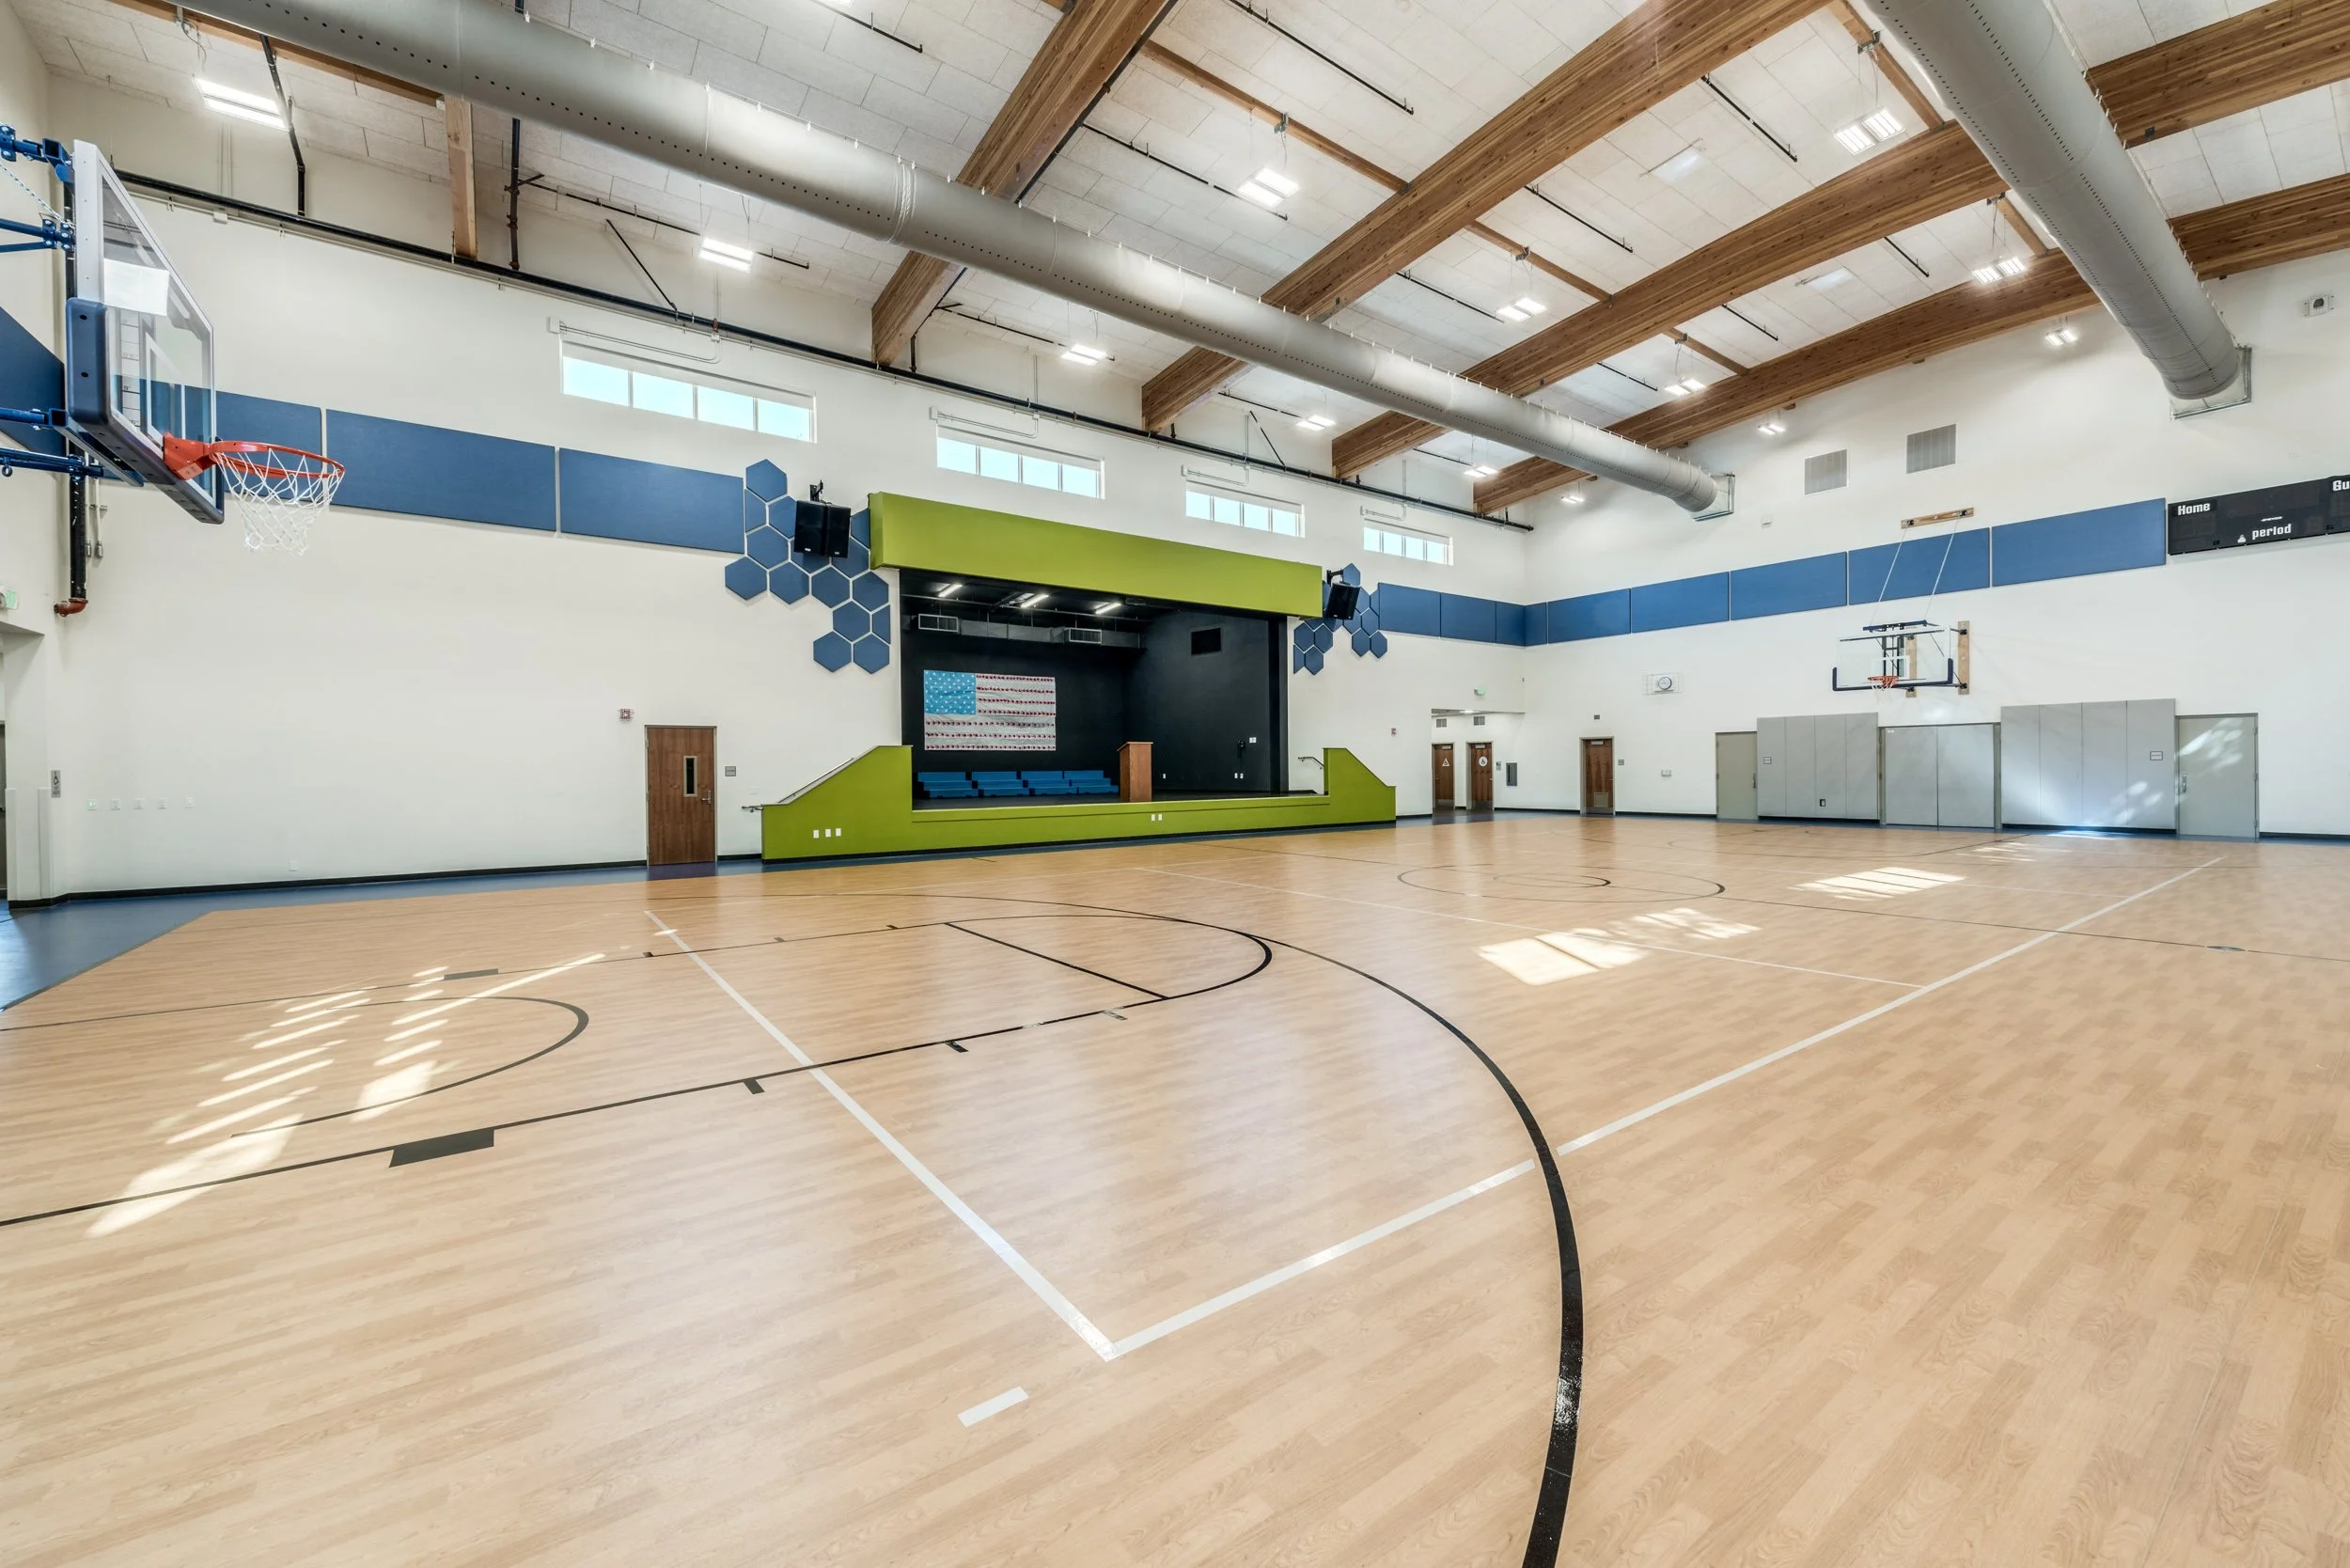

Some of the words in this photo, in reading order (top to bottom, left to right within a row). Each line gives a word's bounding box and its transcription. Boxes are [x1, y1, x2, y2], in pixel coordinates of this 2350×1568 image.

[2332, 479, 2350, 492] Gu
[2177, 503, 2211, 516] Home
[2251, 523, 2292, 541] period
